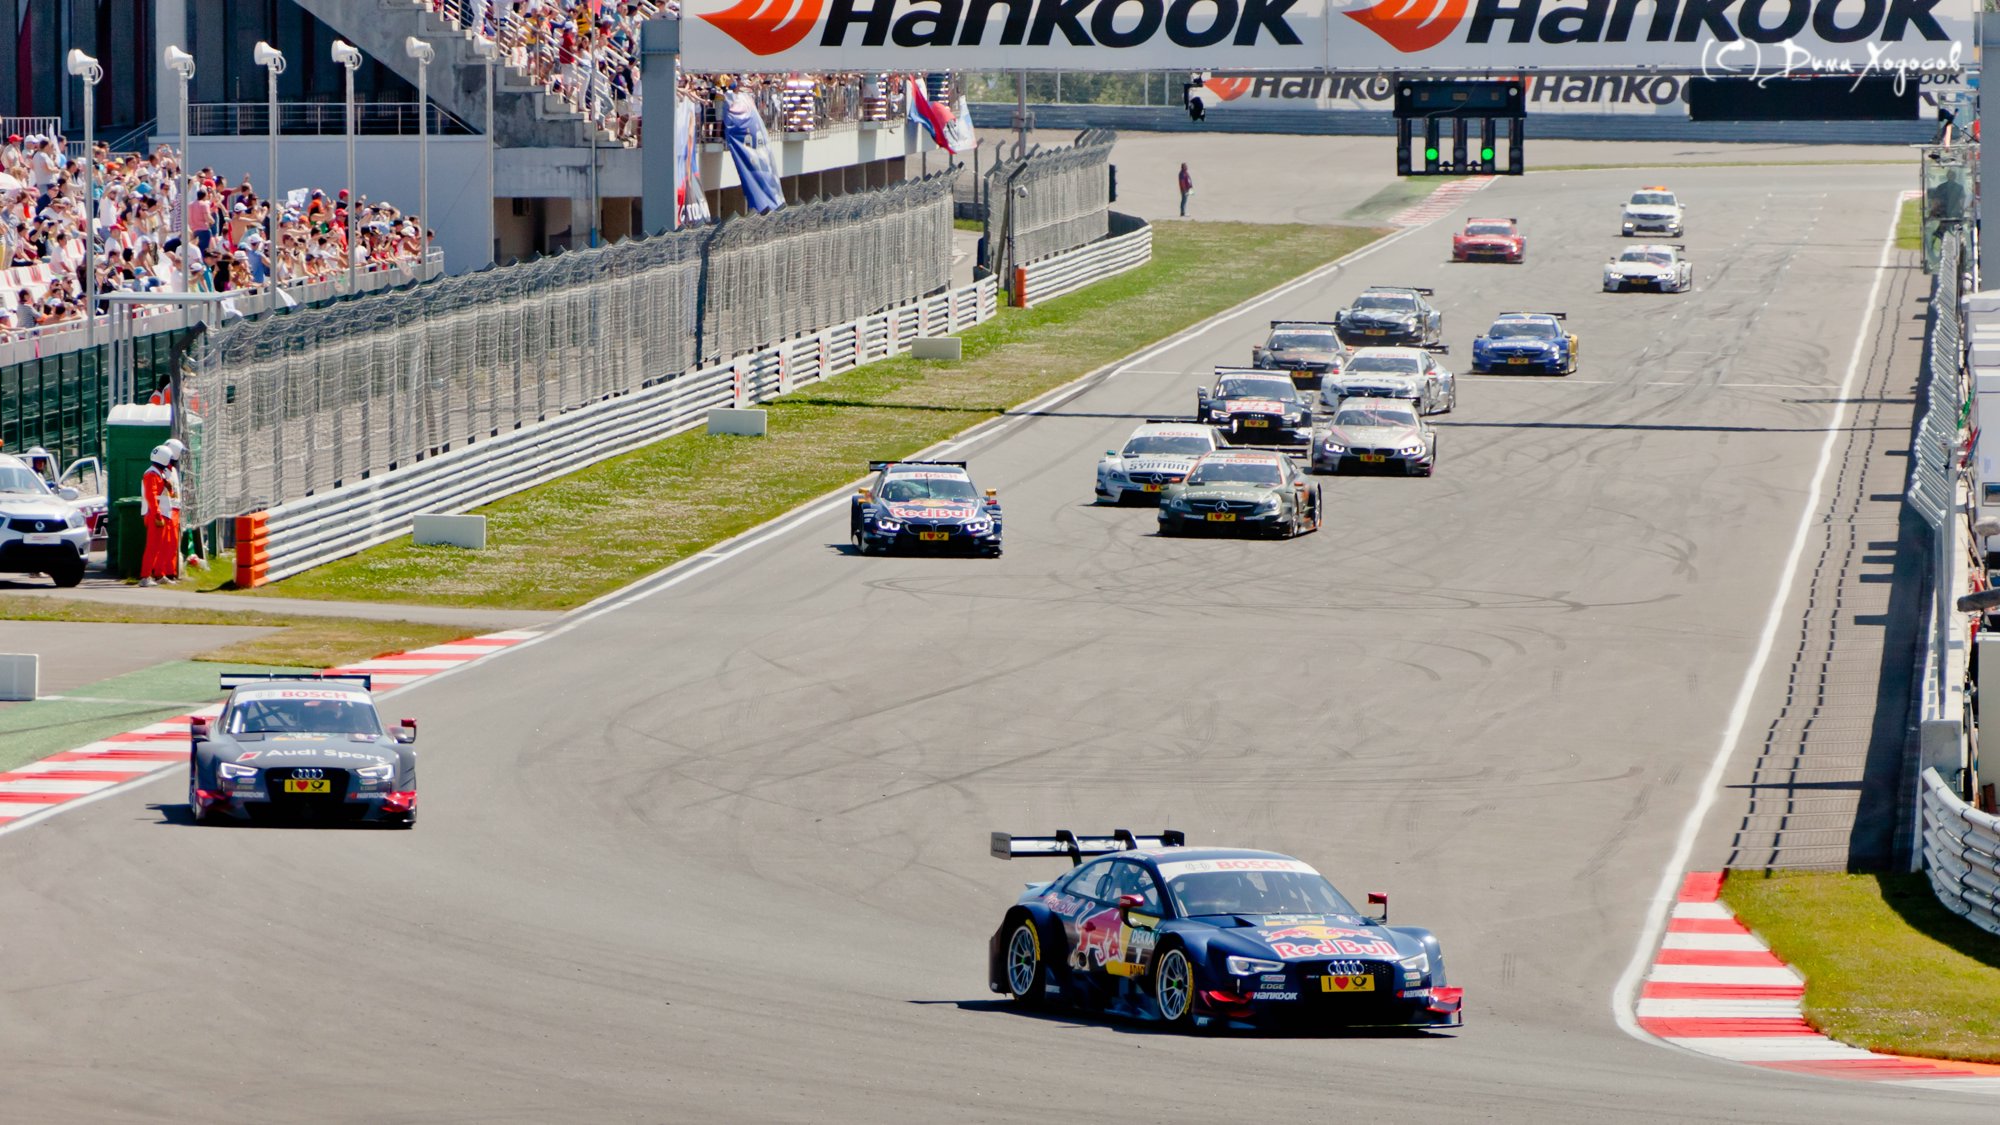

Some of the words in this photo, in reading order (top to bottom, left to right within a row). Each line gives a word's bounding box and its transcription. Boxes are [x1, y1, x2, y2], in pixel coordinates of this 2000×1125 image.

[281, 690, 348, 699] BOSCH
[267, 749, 316, 758] Audi
[323, 749, 386, 763] Sport
[1216, 860, 1296, 870] BOSCH
